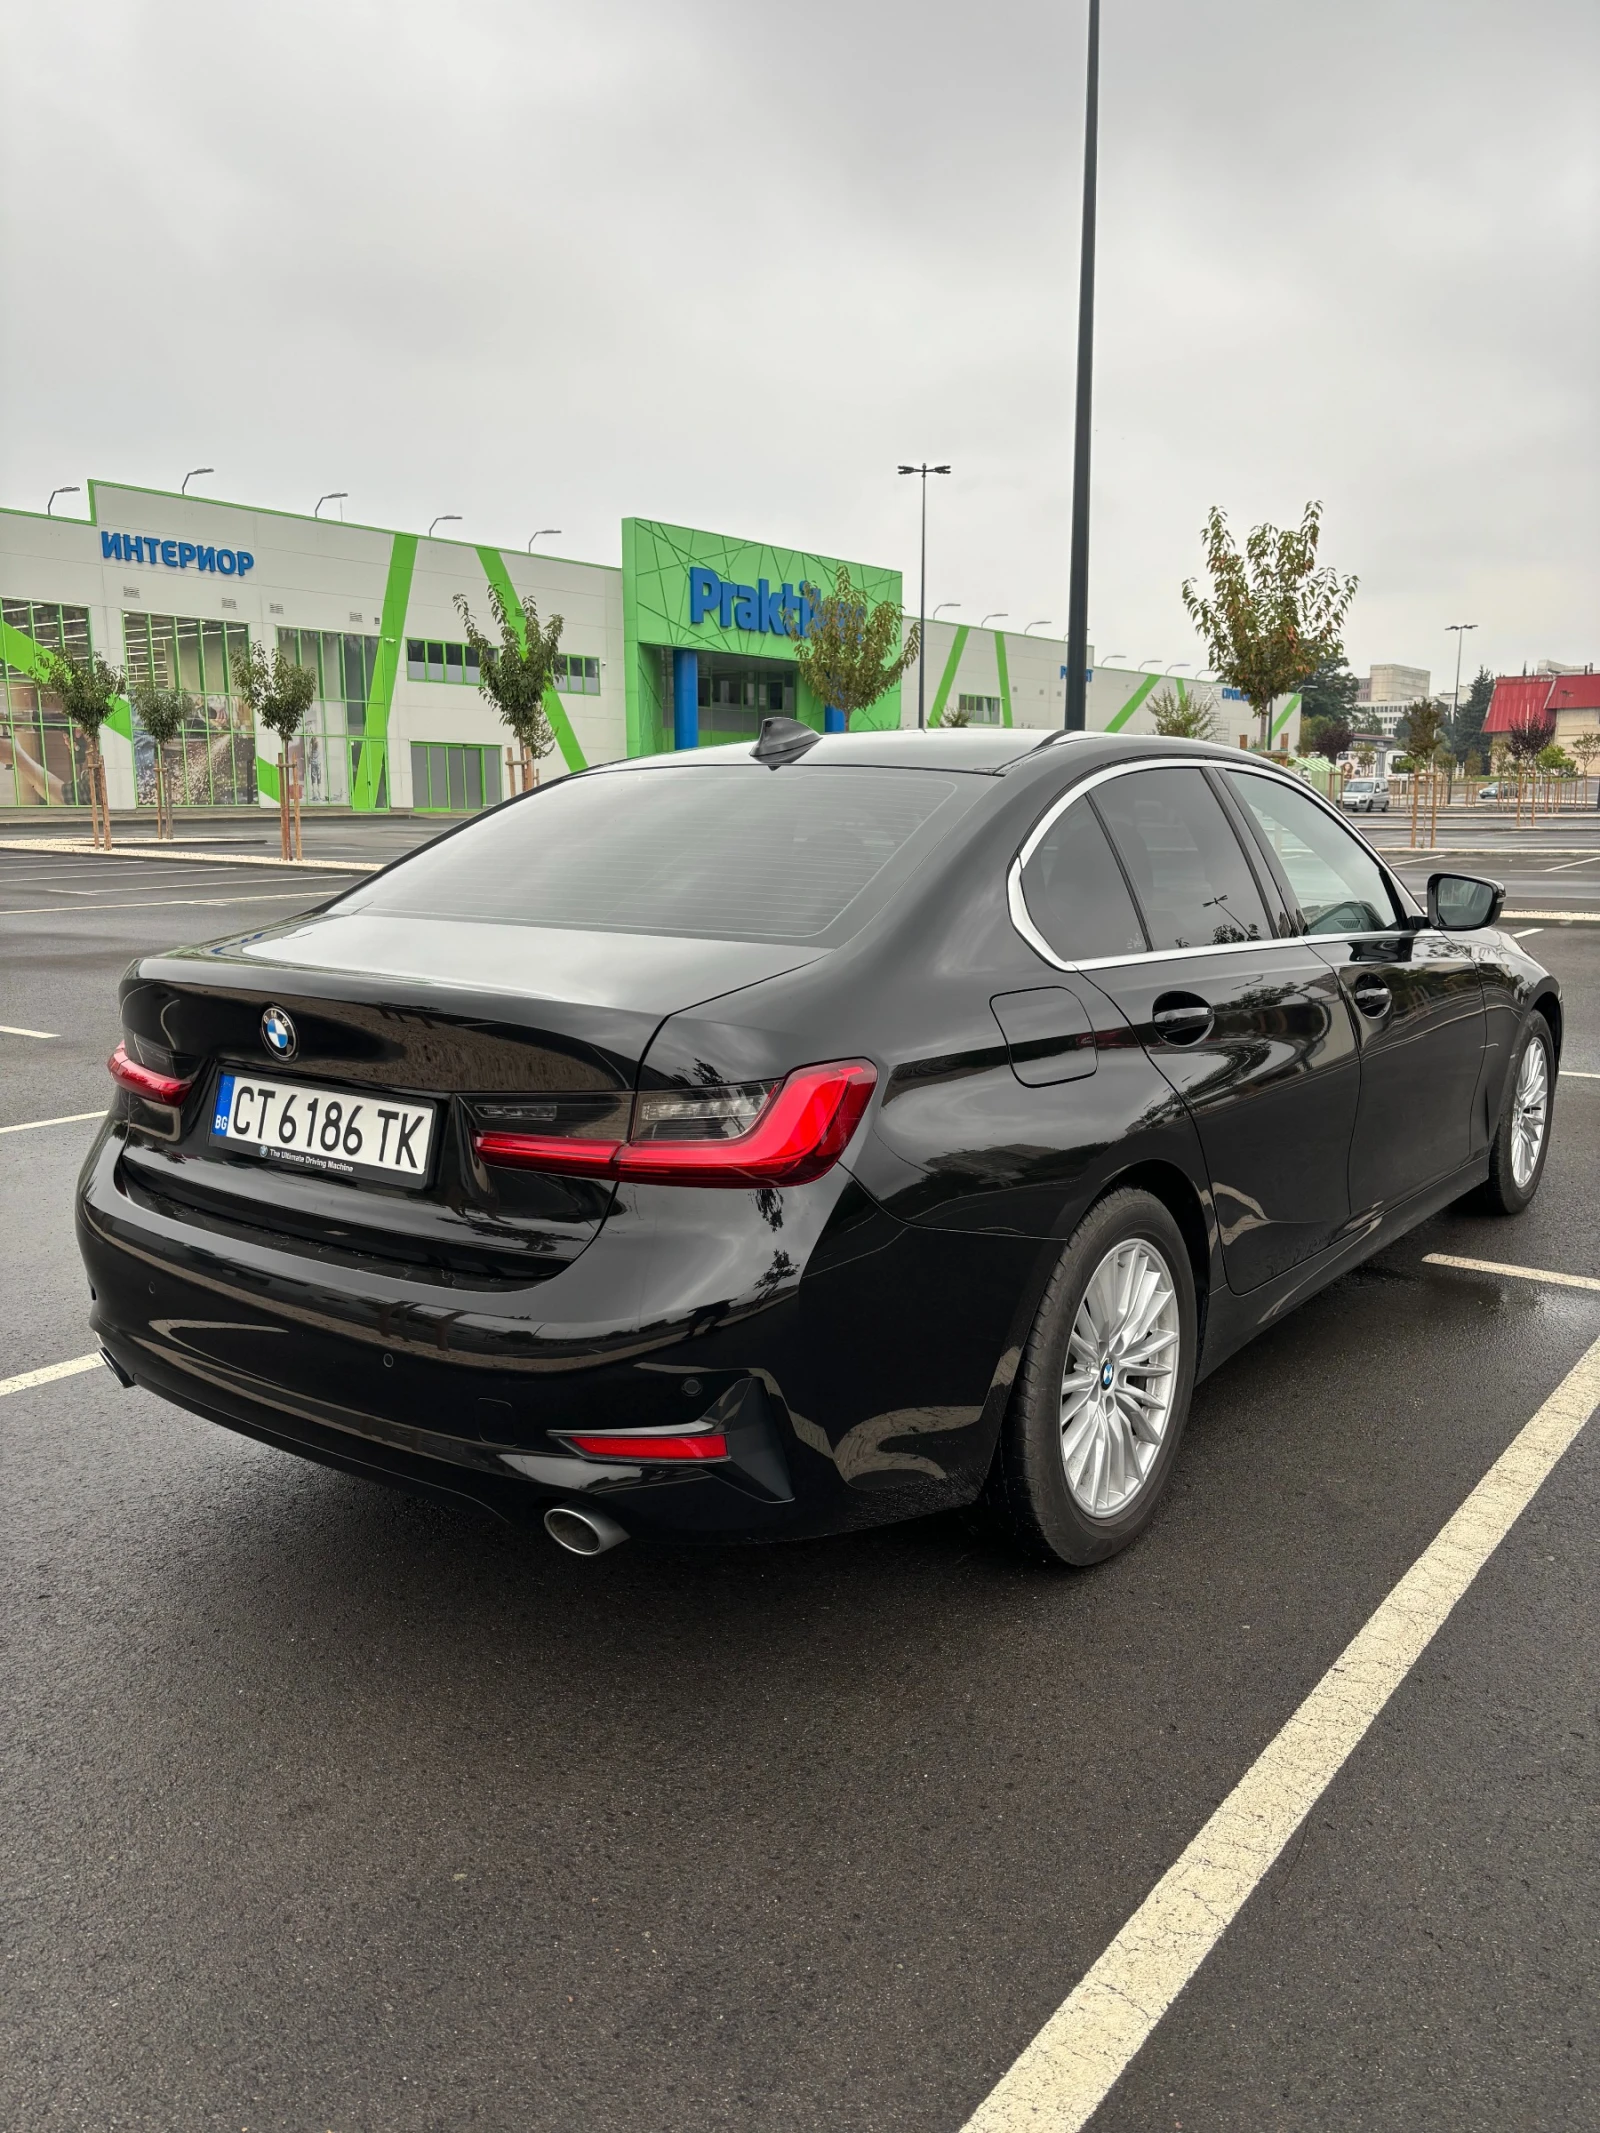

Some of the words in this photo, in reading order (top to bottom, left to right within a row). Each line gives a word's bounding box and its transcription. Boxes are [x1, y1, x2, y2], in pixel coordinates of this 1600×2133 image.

[101, 531, 254, 576] ИНТЕРИОР
[214, 1114, 228, 1130] BG
[270, 1148, 281, 1157] The
[281, 1151, 305, 1162] Ultimate
[305, 1156, 327, 1169] Driving
[327, 1160, 354, 1172] Machine
